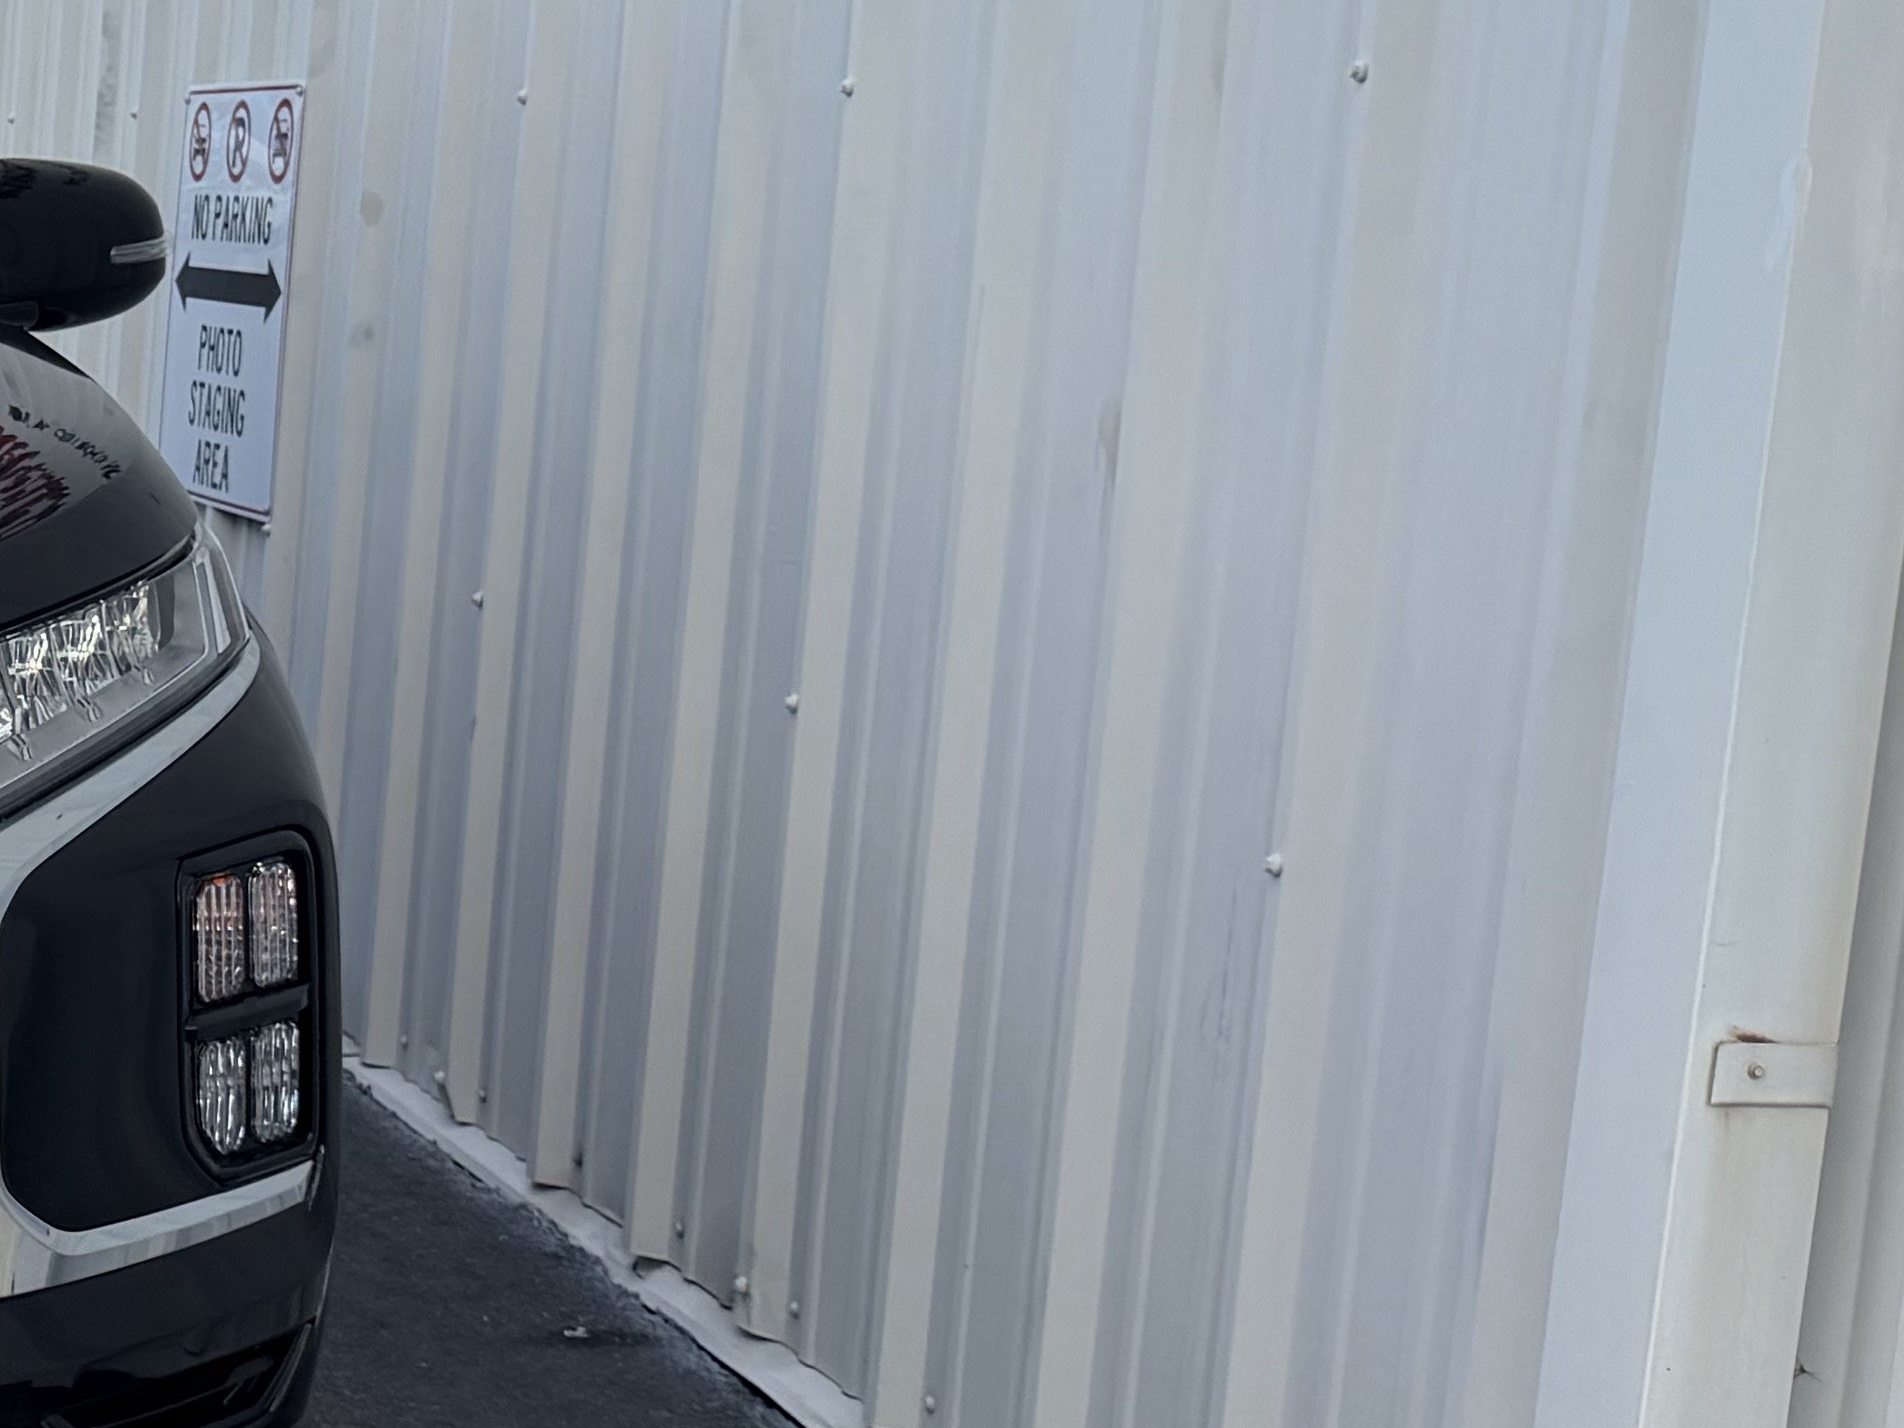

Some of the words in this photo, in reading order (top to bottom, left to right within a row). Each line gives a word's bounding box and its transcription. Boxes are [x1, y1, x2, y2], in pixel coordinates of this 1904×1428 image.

[191, 193, 210, 241] NO
[212, 194, 274, 245] PARKING
[197, 324, 243, 377] PHOTO
[188, 379, 245, 438] STAGING
[192, 438, 229, 493] AREA
